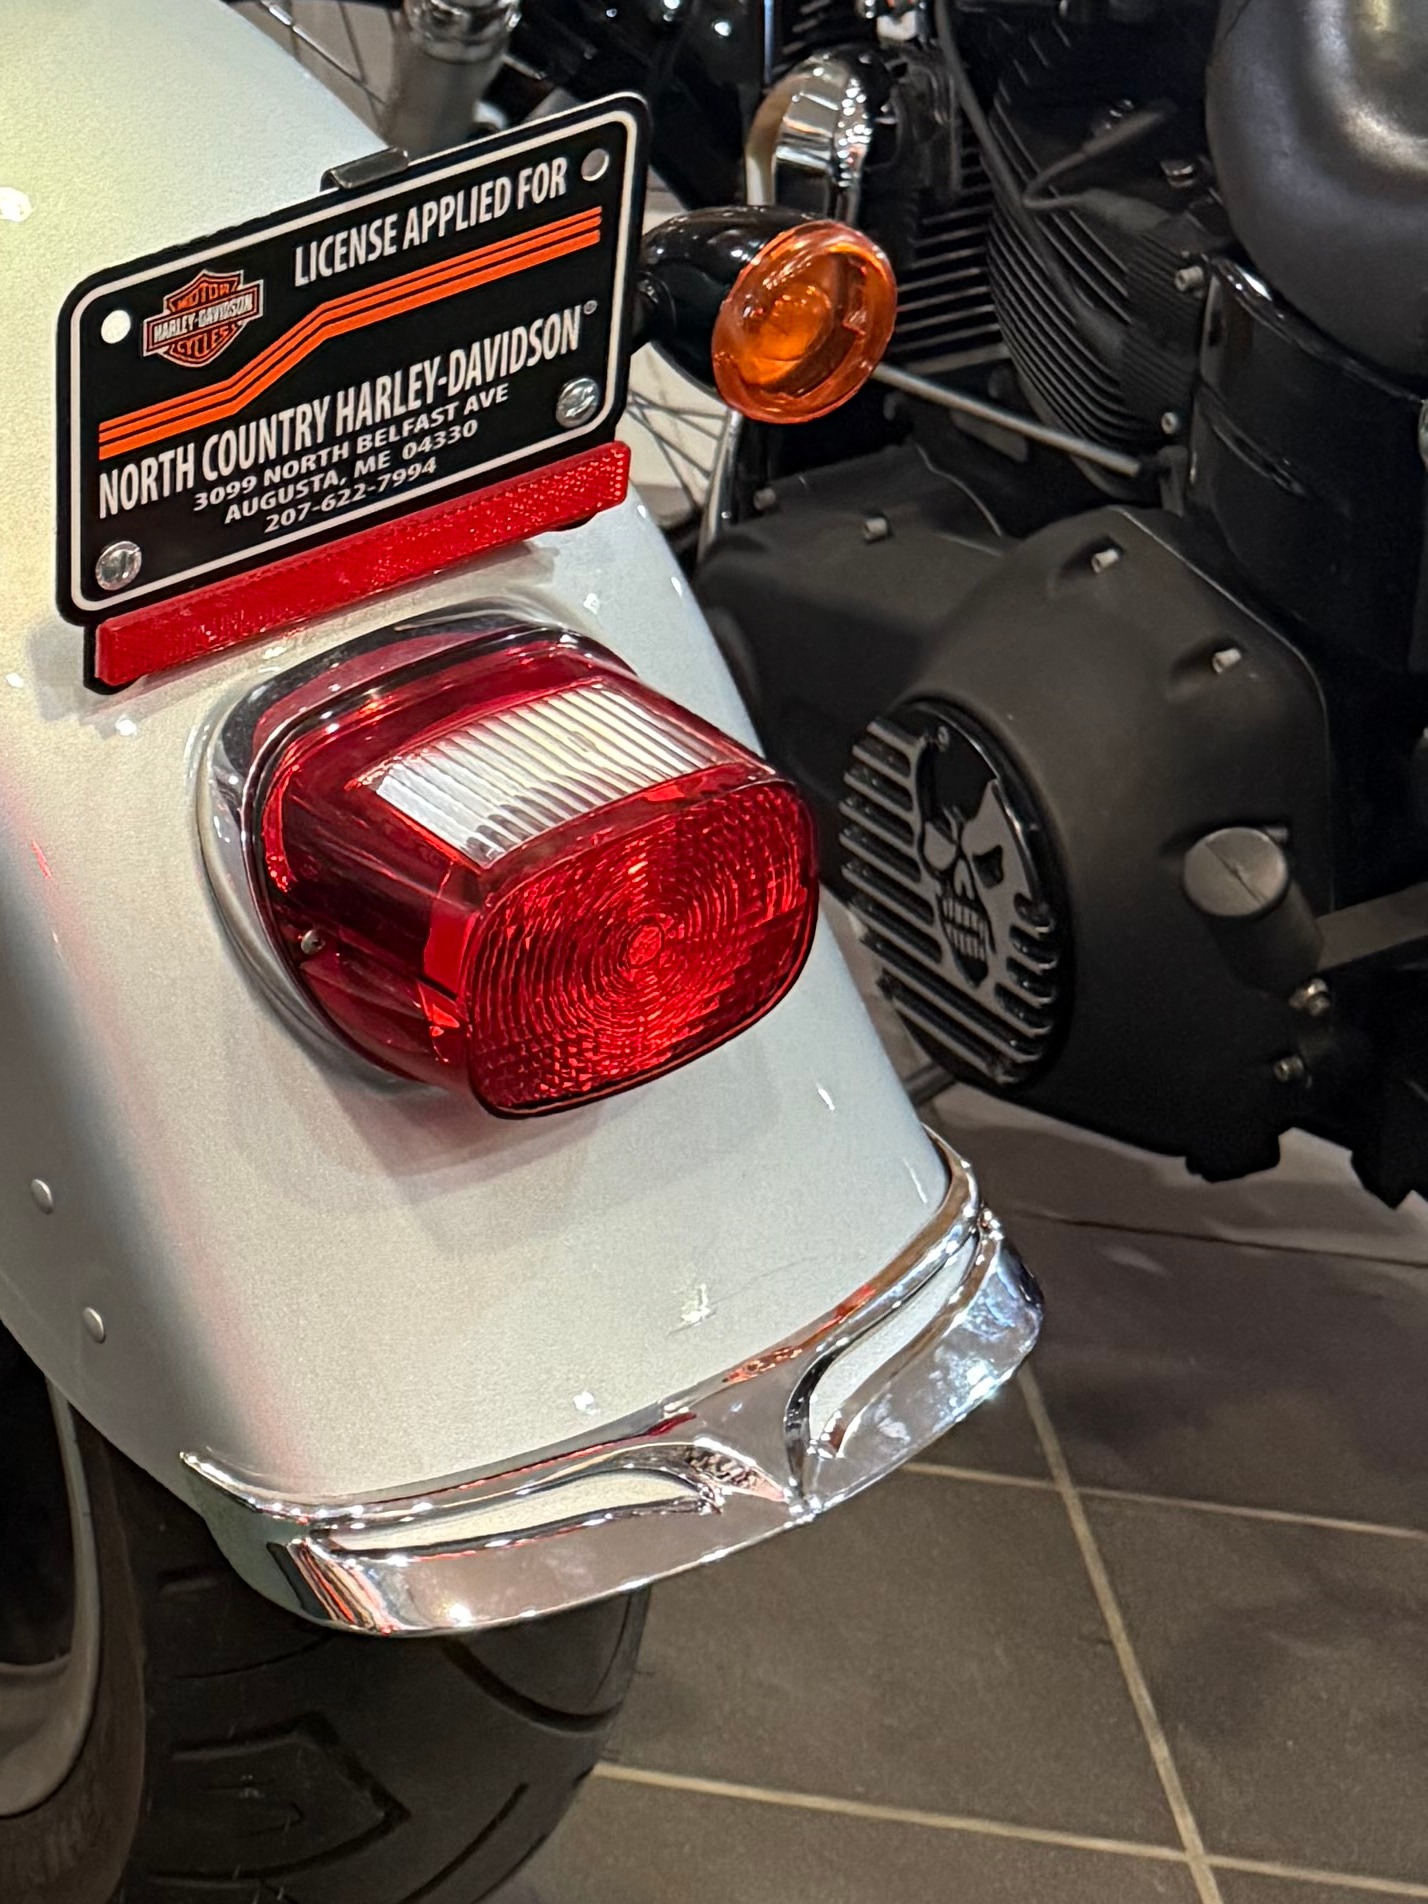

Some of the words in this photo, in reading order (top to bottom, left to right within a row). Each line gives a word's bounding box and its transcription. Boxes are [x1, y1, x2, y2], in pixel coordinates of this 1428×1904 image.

[295, 213, 399, 287] LICENSE
[402, 176, 512, 250] APPLIED
[517, 156, 568, 210] FOR
[153, 293, 253, 343] HARLEY-DAVIDSON
[177, 282, 230, 312] MOTOR
[177, 325, 229, 358] CYCLES
[99, 442, 194, 519] NORTH
[202, 395, 331, 481] COUNTRY
[194, 476, 257, 512] 3099
[263, 441, 349, 487] NORTH
[356, 400, 460, 454] BELFAST
[463, 383, 509, 415] AVE
[224, 467, 347, 525] AUGUSTA,
[353, 450, 391, 479] ME
[402, 420, 478, 460] 04330
[264, 456, 437, 533] 207-622-7994
